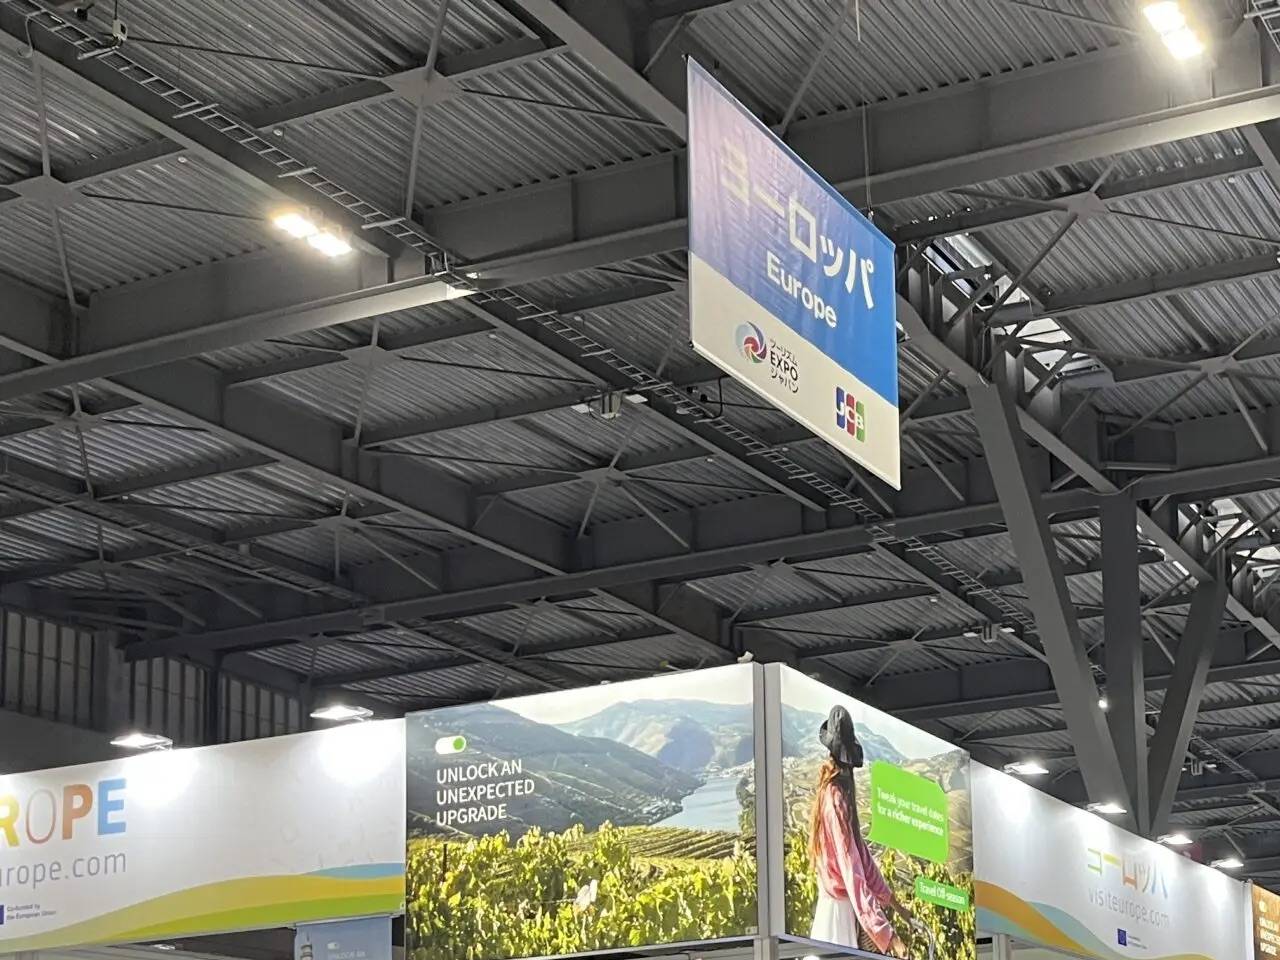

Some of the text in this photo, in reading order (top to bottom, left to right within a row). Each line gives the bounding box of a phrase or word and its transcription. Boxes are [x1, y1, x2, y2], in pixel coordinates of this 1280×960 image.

[721, 136, 875, 310] ヨーロッパ
[766, 250, 837, 328] Europe
[770, 351, 798, 381] EXPO
[770, 368, 799, 394] ジャパン
[436, 759, 522, 784] UNLOCK AN
[436, 779, 535, 805] UNEXPECTED
[436, 804, 507, 826] UPGRADE
[0, 852, 126, 889] rope.com
[919, 881, 936, 897] Travel
